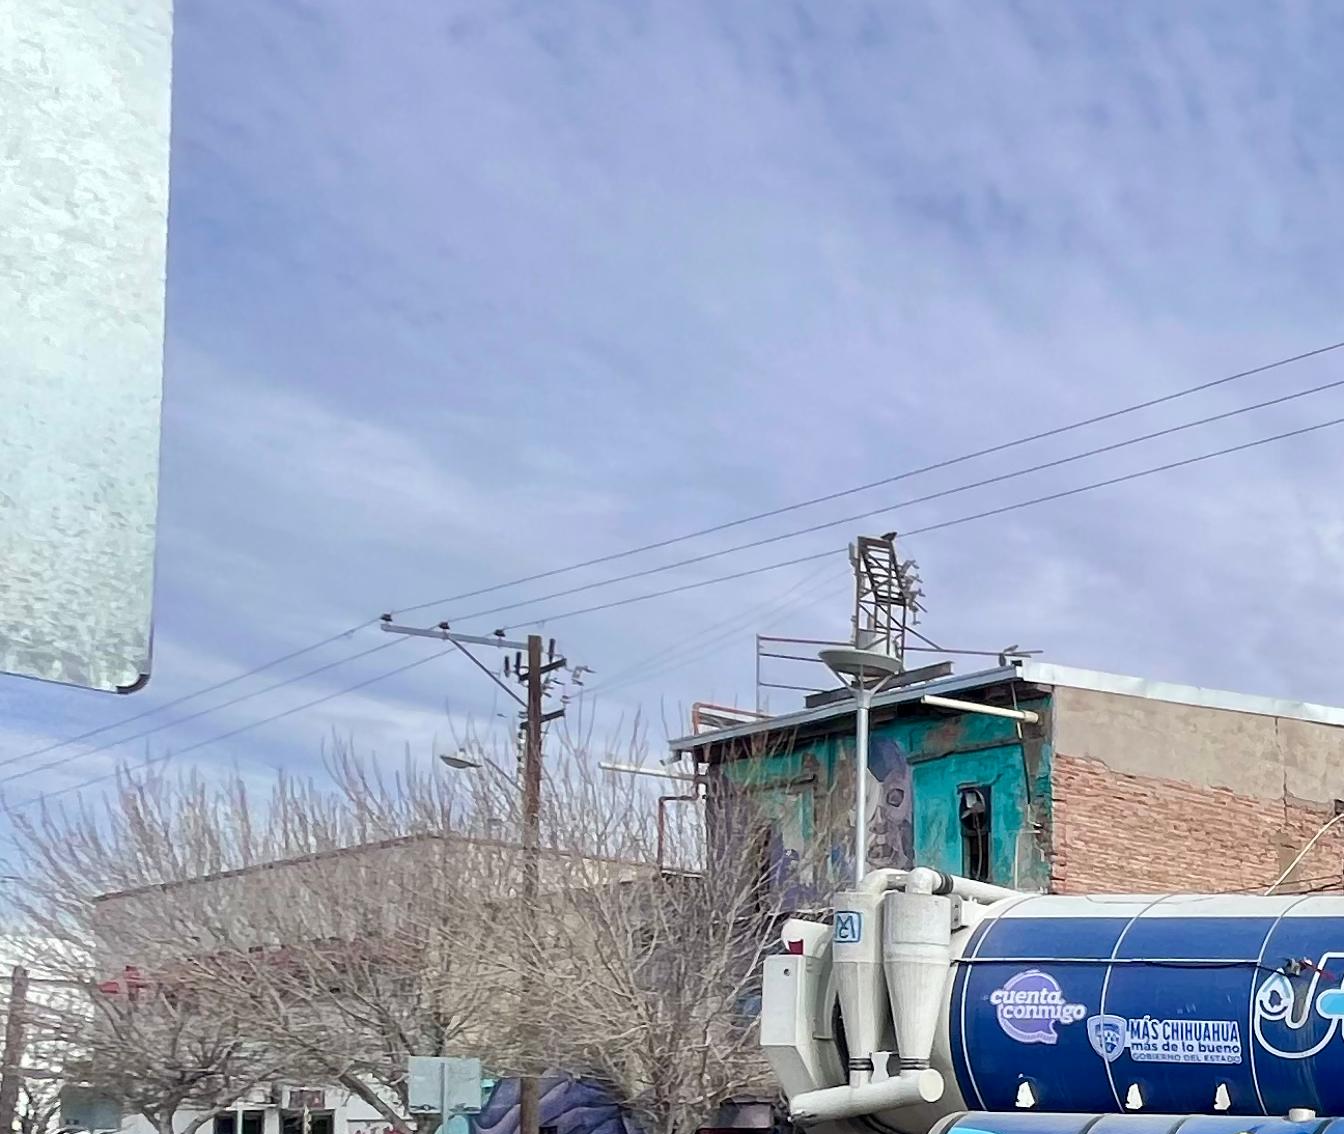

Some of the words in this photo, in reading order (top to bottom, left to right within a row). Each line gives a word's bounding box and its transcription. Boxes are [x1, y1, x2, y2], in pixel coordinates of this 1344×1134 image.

[990, 988, 1066, 1005] cuenta
[1003, 1004, 1087, 1024] conmigo
[1162, 1021, 1239, 1042] CHIHUAHUA
[1162, 1041, 1178, 1052] de
[1182, 1041, 1194, 1052] lo
[1198, 1041, 1240, 1053] bueno
